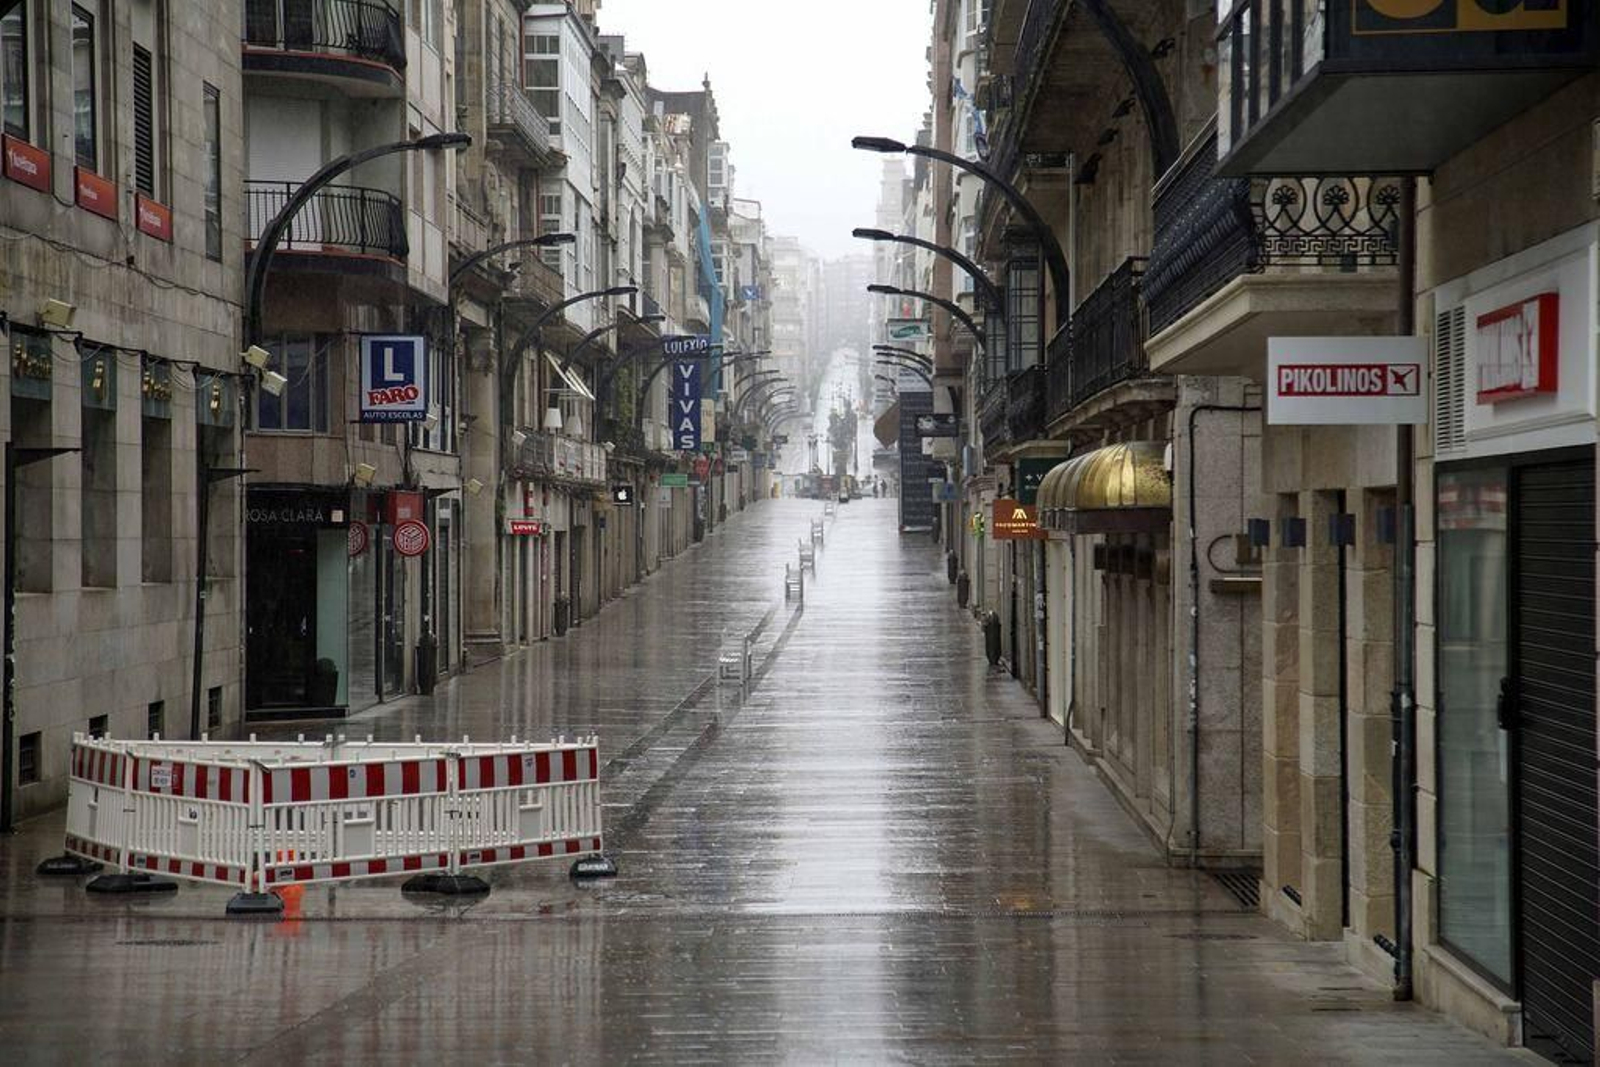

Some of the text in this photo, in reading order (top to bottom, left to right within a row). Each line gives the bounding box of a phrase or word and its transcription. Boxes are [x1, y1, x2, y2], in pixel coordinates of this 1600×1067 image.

[384, 347, 404, 381] L
[1280, 367, 1383, 394] PIKOLINOS
[367, 385, 419, 406] FARO
[679, 364, 695, 449] VIVAS
[363, 411, 423, 419] AUTO ESCOLAS
